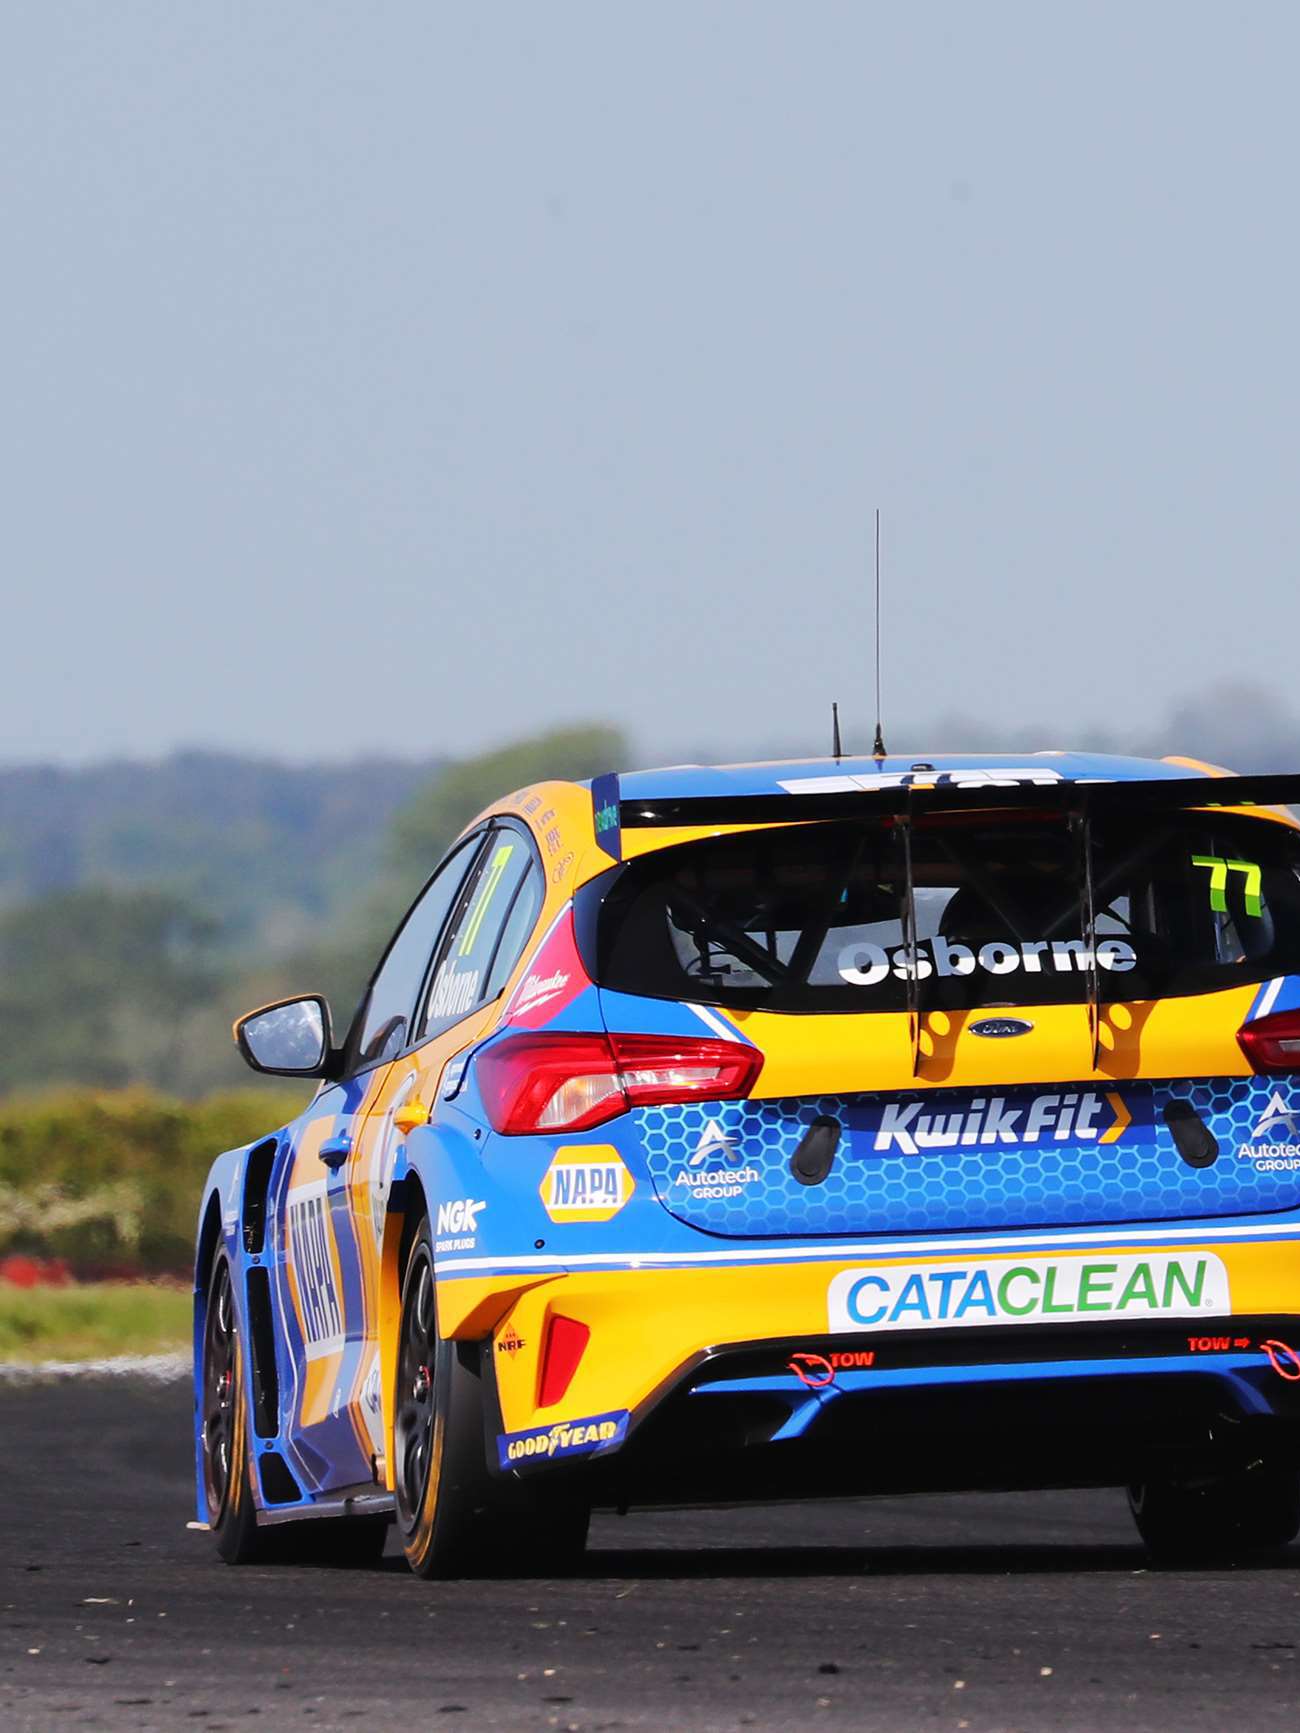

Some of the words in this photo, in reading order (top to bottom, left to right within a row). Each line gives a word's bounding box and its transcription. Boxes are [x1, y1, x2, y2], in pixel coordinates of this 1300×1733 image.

[1192, 855, 1262, 918] 77
[838, 936, 1137, 985] Osborne
[554, 1168, 618, 1206] NAPA
[675, 1167, 758, 1187] Autotech
[693, 1186, 743, 1199] GROUP
[436, 1199, 487, 1235] NGK
[847, 1260, 1207, 1324] CATACLEAN
[498, 1339, 526, 1352] NRF
[830, 1352, 874, 1368] TOW
[1188, 1336, 1231, 1351] TOW
[508, 1421, 617, 1460] GOODYEAR
